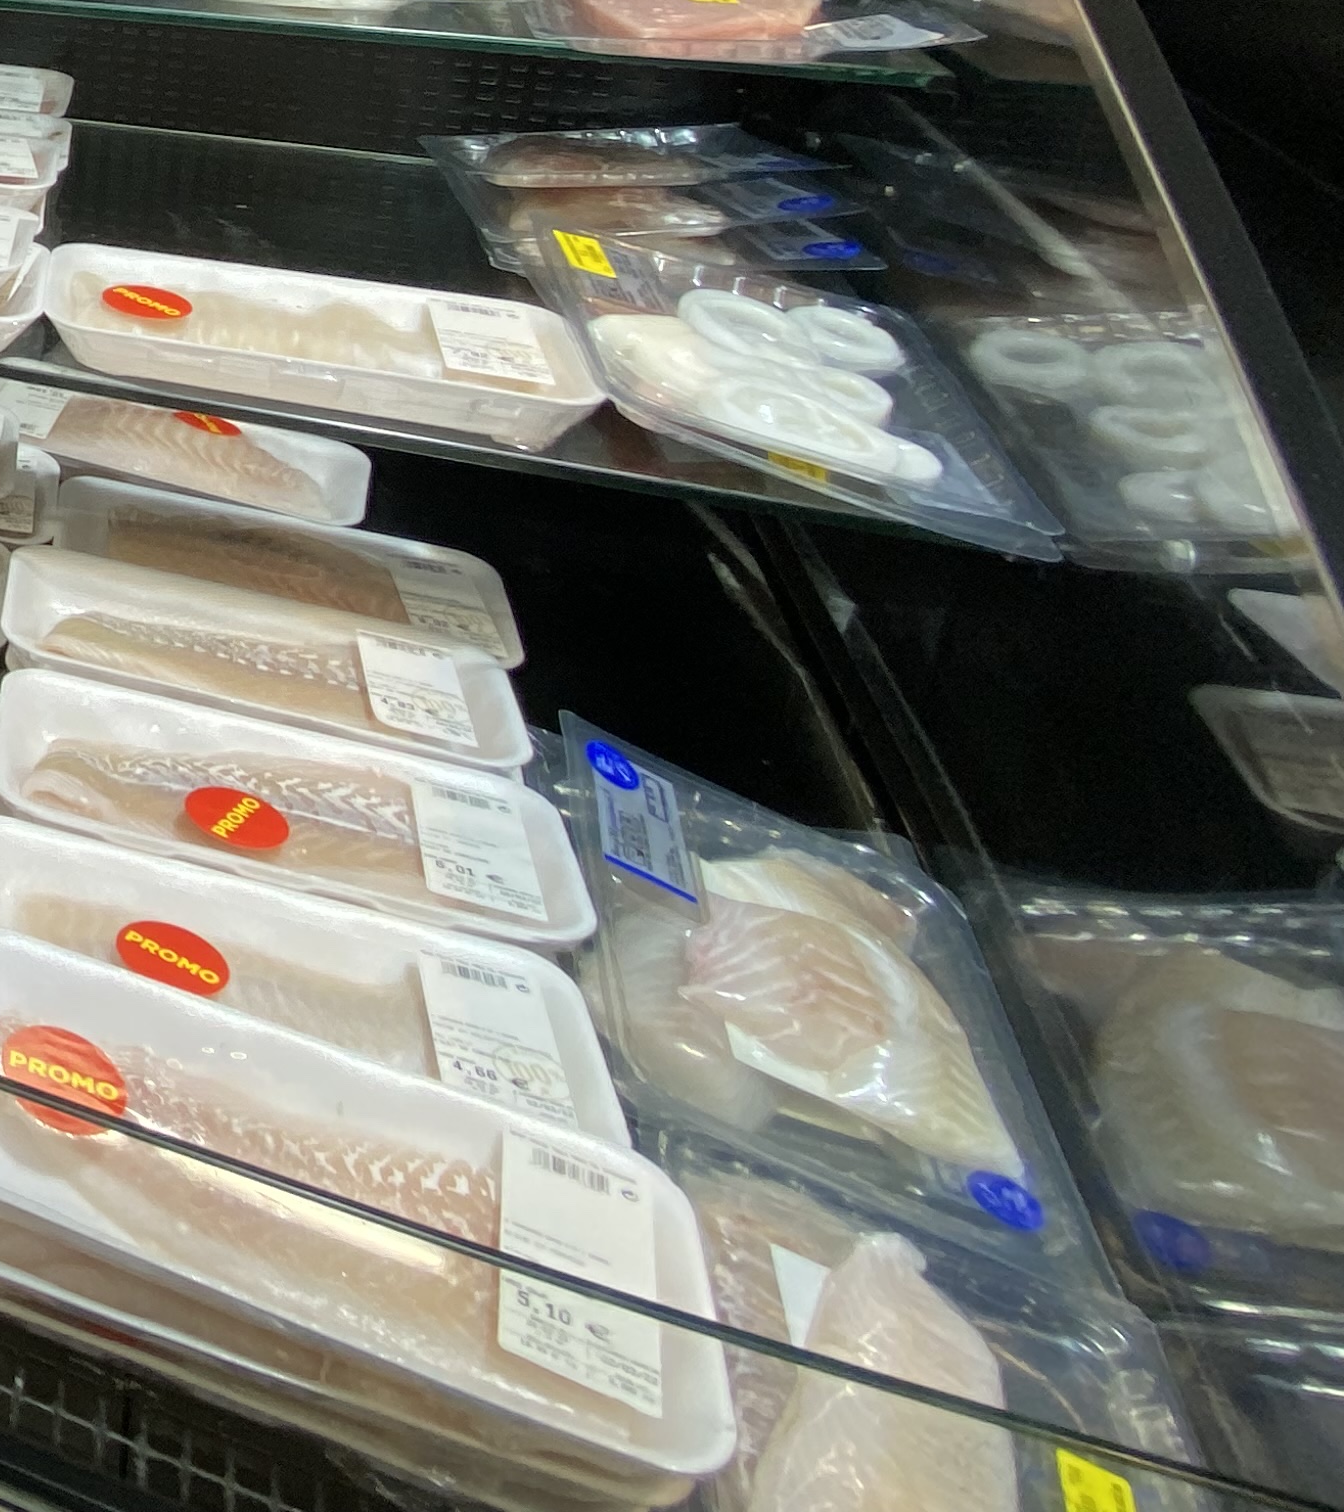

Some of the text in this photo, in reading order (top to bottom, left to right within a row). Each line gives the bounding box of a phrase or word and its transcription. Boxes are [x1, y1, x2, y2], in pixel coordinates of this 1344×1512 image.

[112, 286, 181, 320] PROMO
[212, 796, 261, 840] PROMO
[124, 928, 222, 988] PROMO
[9, 1048, 120, 1103] PROMO
[517, 1291, 572, 1326] 5.10
